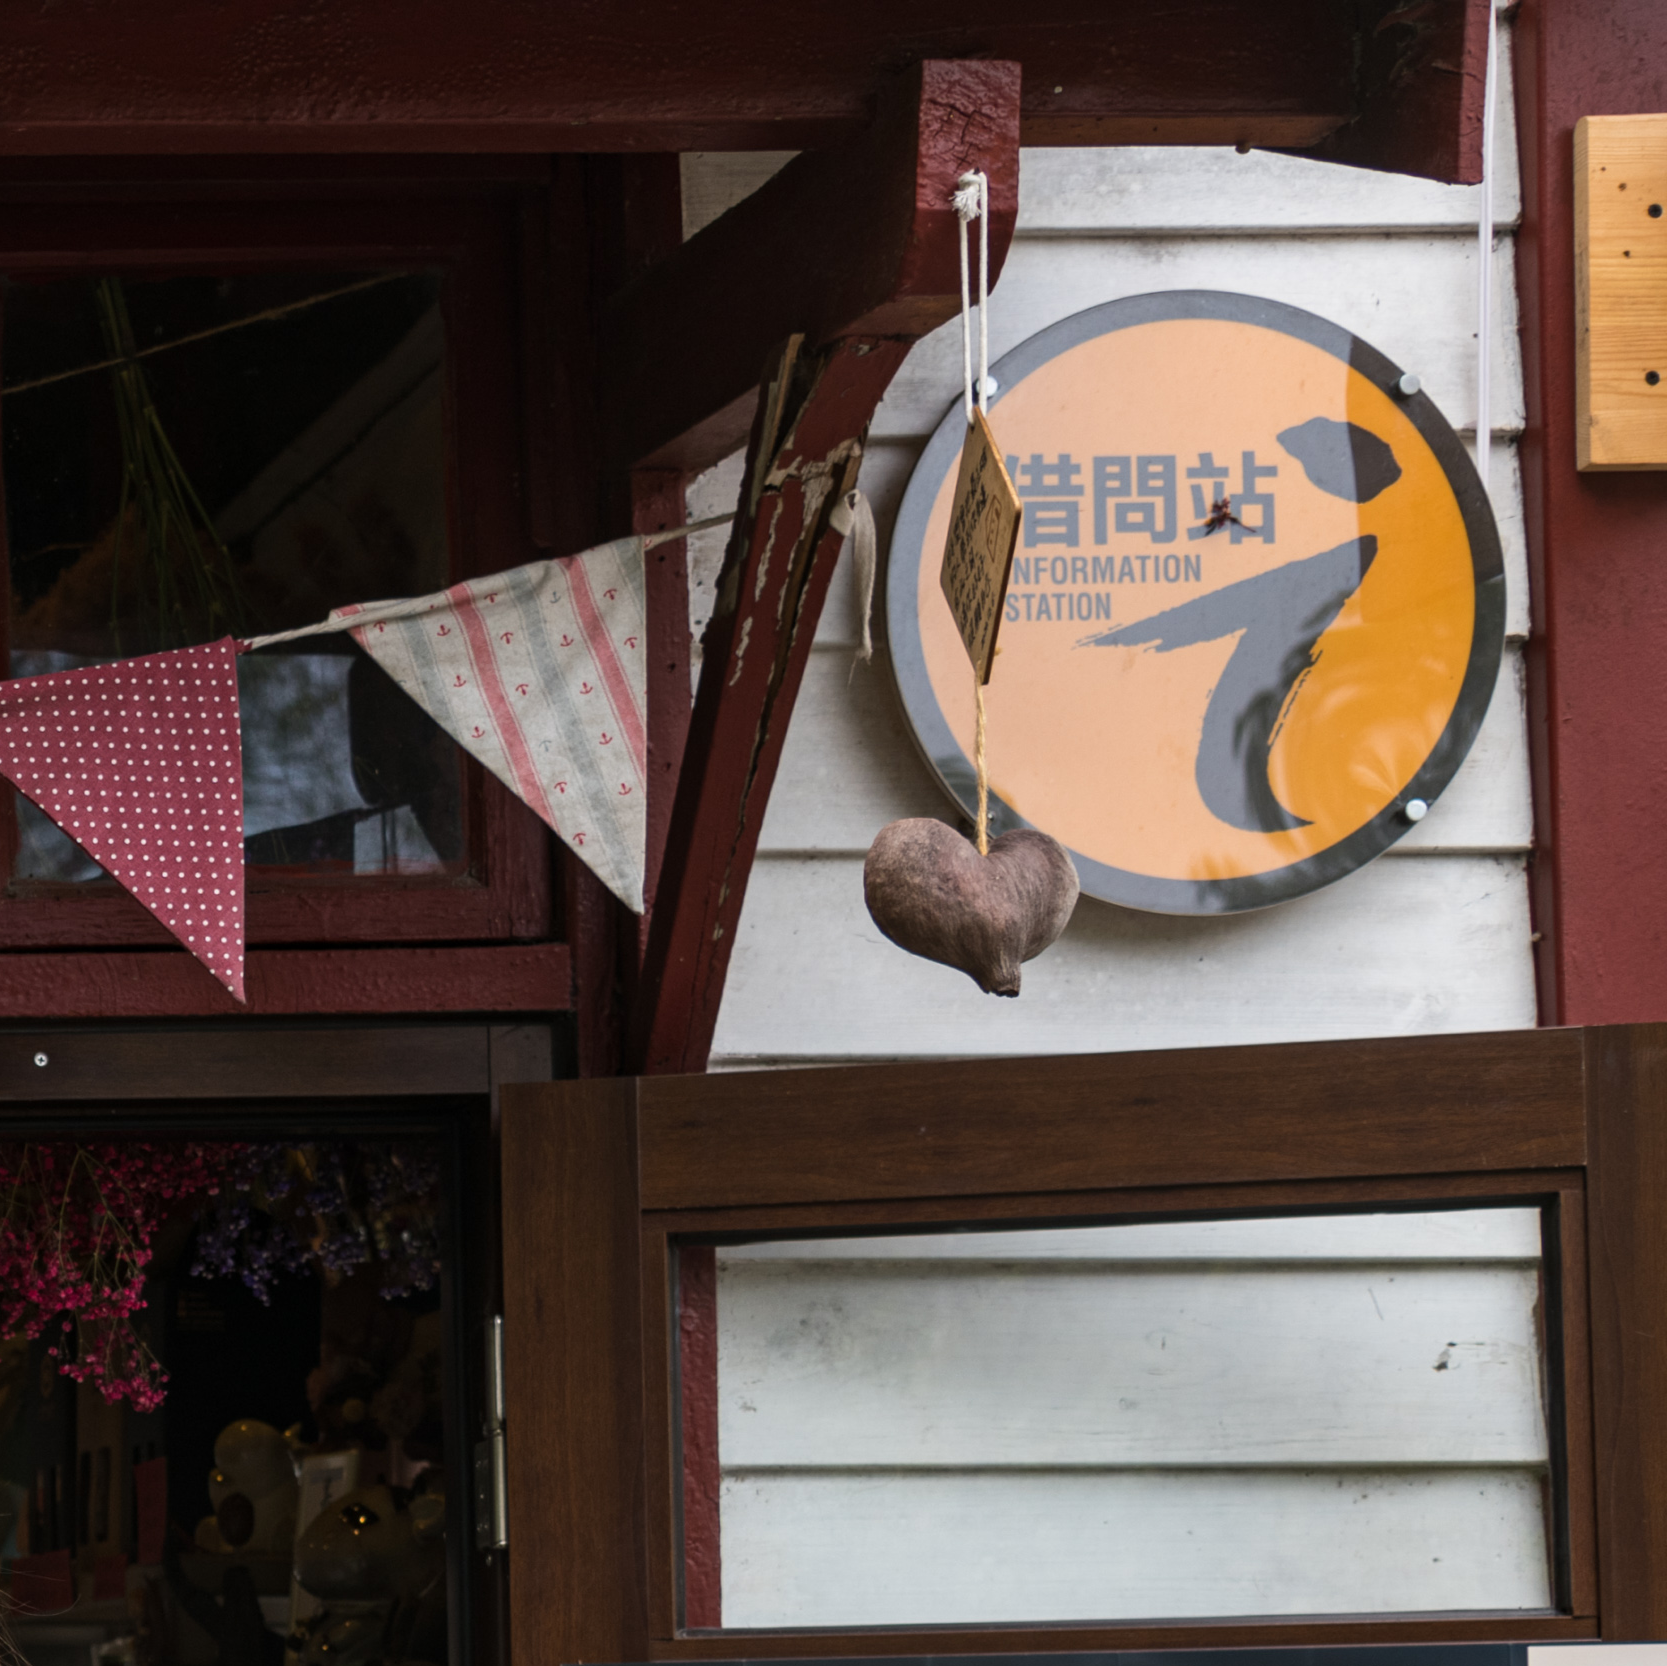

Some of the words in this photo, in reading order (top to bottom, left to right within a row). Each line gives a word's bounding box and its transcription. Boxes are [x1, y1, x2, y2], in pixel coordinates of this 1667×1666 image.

[1005, 451, 1278, 547] 借問站
[1012, 554, 1201, 585] NFORMATION
[1004, 593, 1111, 622] STATION
